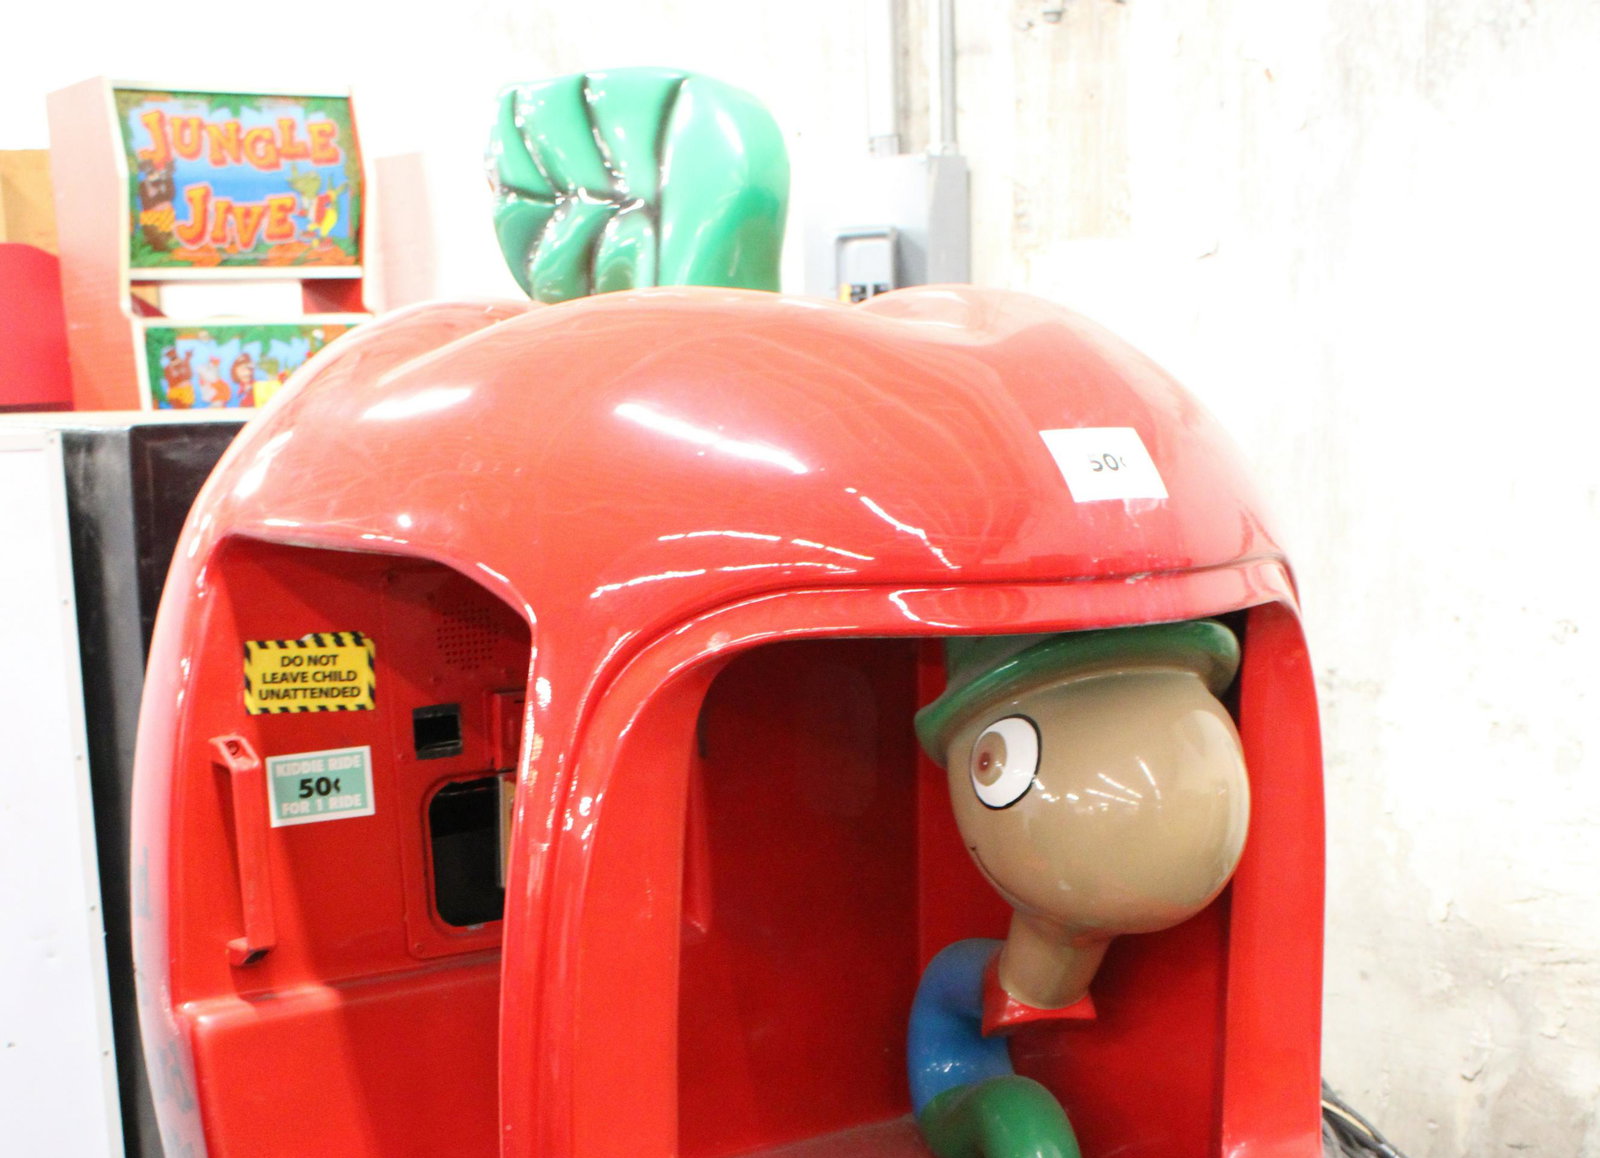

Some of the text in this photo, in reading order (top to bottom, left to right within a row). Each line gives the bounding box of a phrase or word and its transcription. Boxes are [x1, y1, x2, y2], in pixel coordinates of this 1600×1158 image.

[139, 110, 341, 171] JUNGLE
[175, 183, 298, 249] JIVE
[281, 655, 339, 668] DO NOT
[262, 671, 357, 684] LEAVE CHILD
[258, 687, 361, 700] UNATTENDED
[329, 755, 361, 771] RIDE
[282, 801, 311, 816] FOR
[329, 794, 361, 809] RIDE
